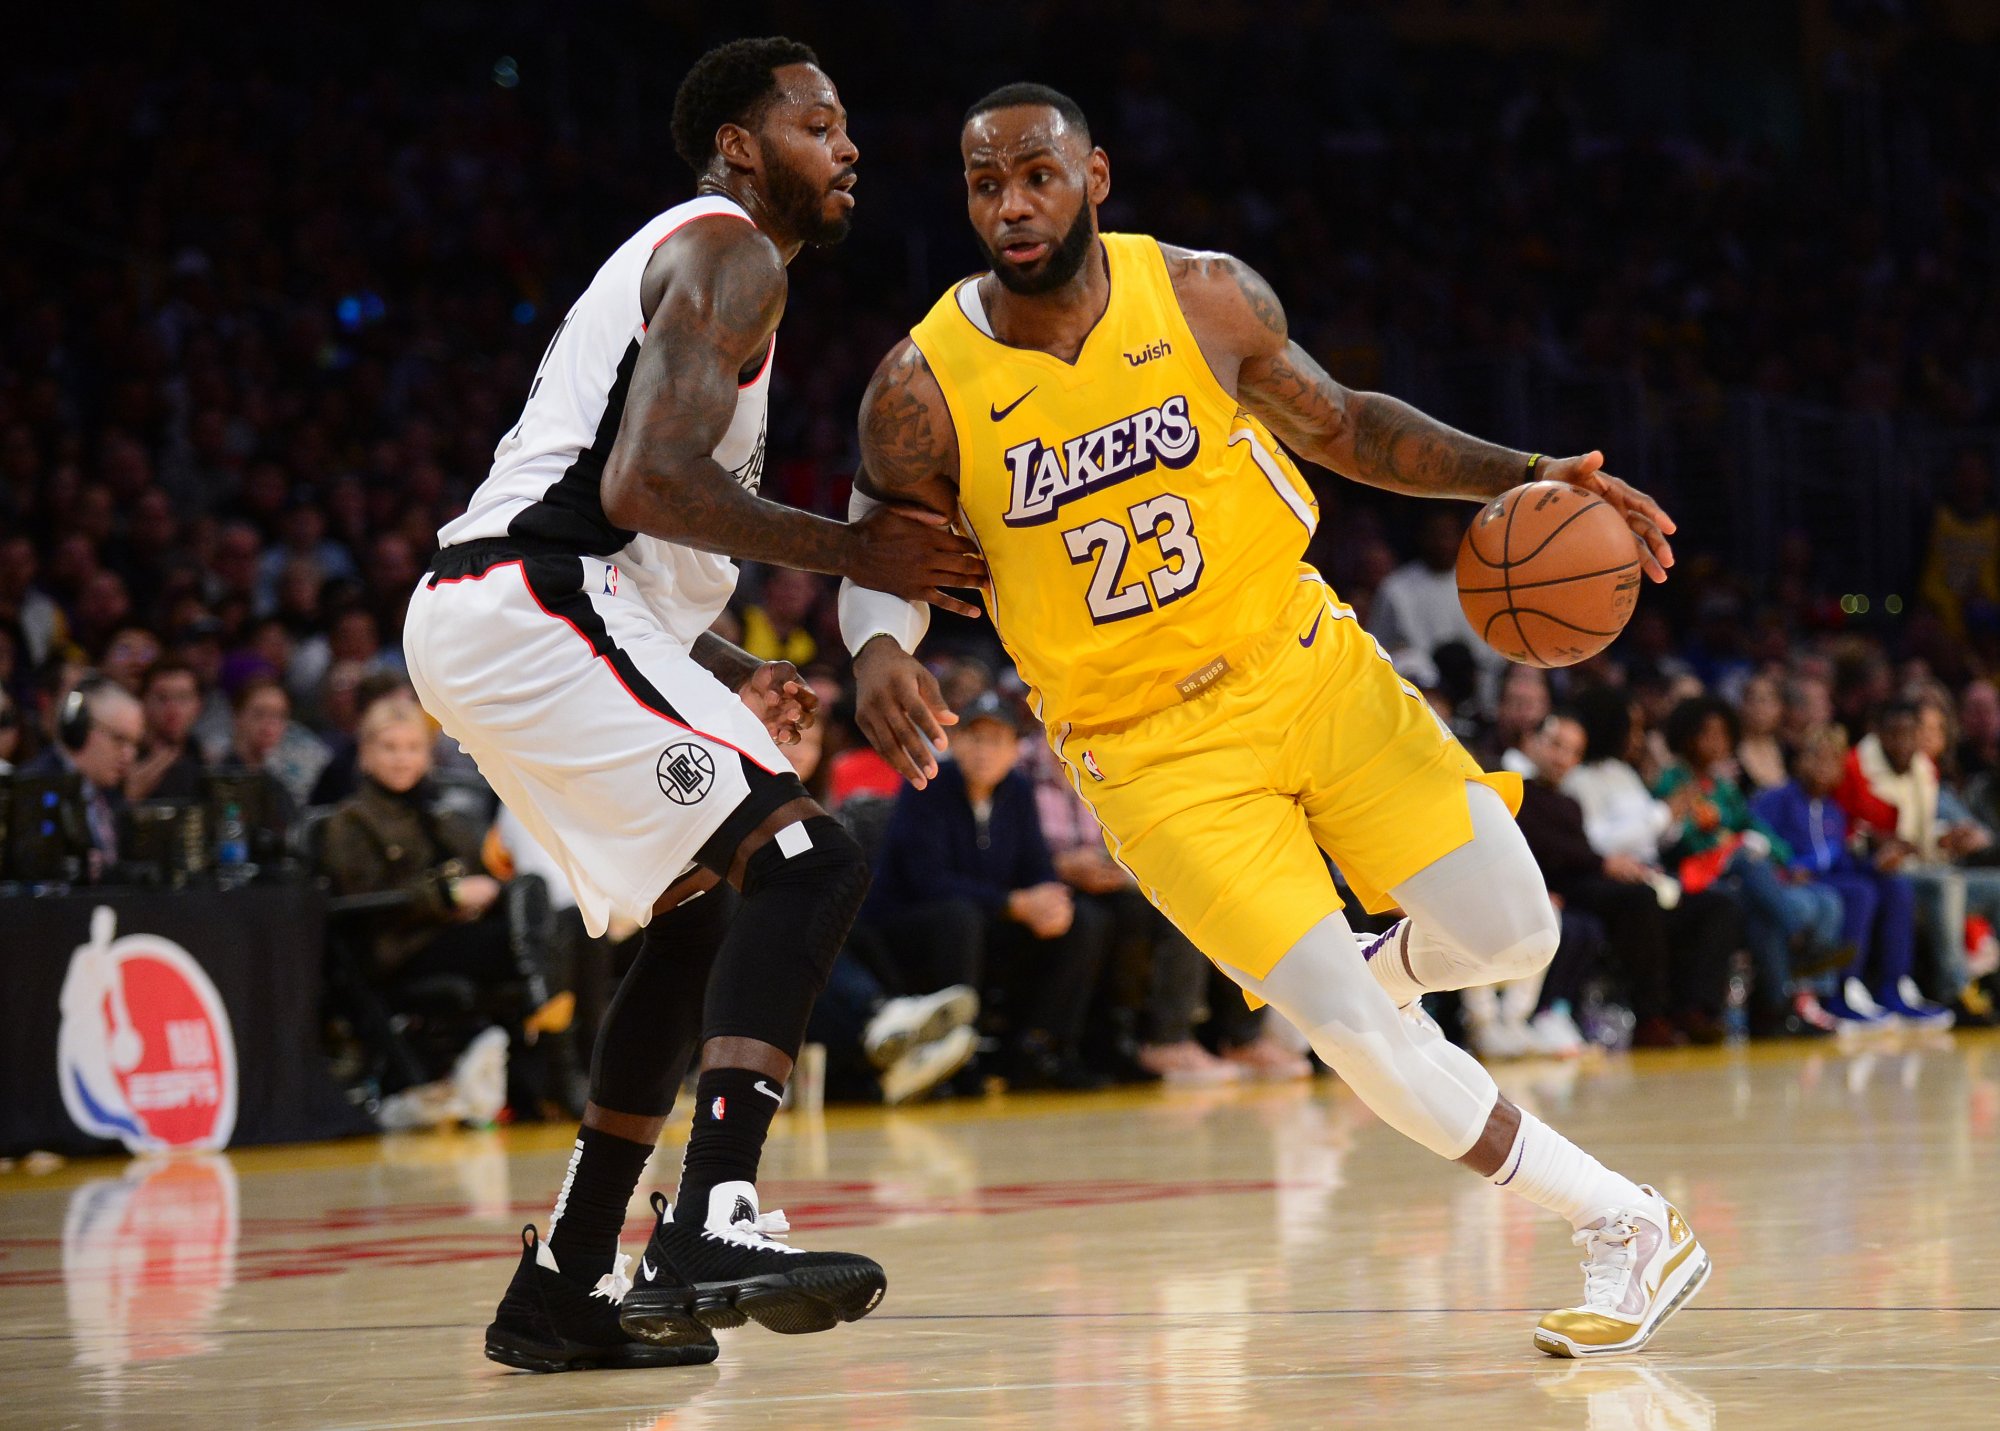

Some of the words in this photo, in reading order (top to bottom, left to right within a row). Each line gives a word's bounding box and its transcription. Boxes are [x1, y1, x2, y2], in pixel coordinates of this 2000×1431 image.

[1123, 339, 1171, 366] wish
[1003, 395, 1200, 527] LAKERS
[1061, 493, 1204, 626] 23
[1182, 681, 1200, 693] DR.
[1201, 662, 1224, 684] BUSS
